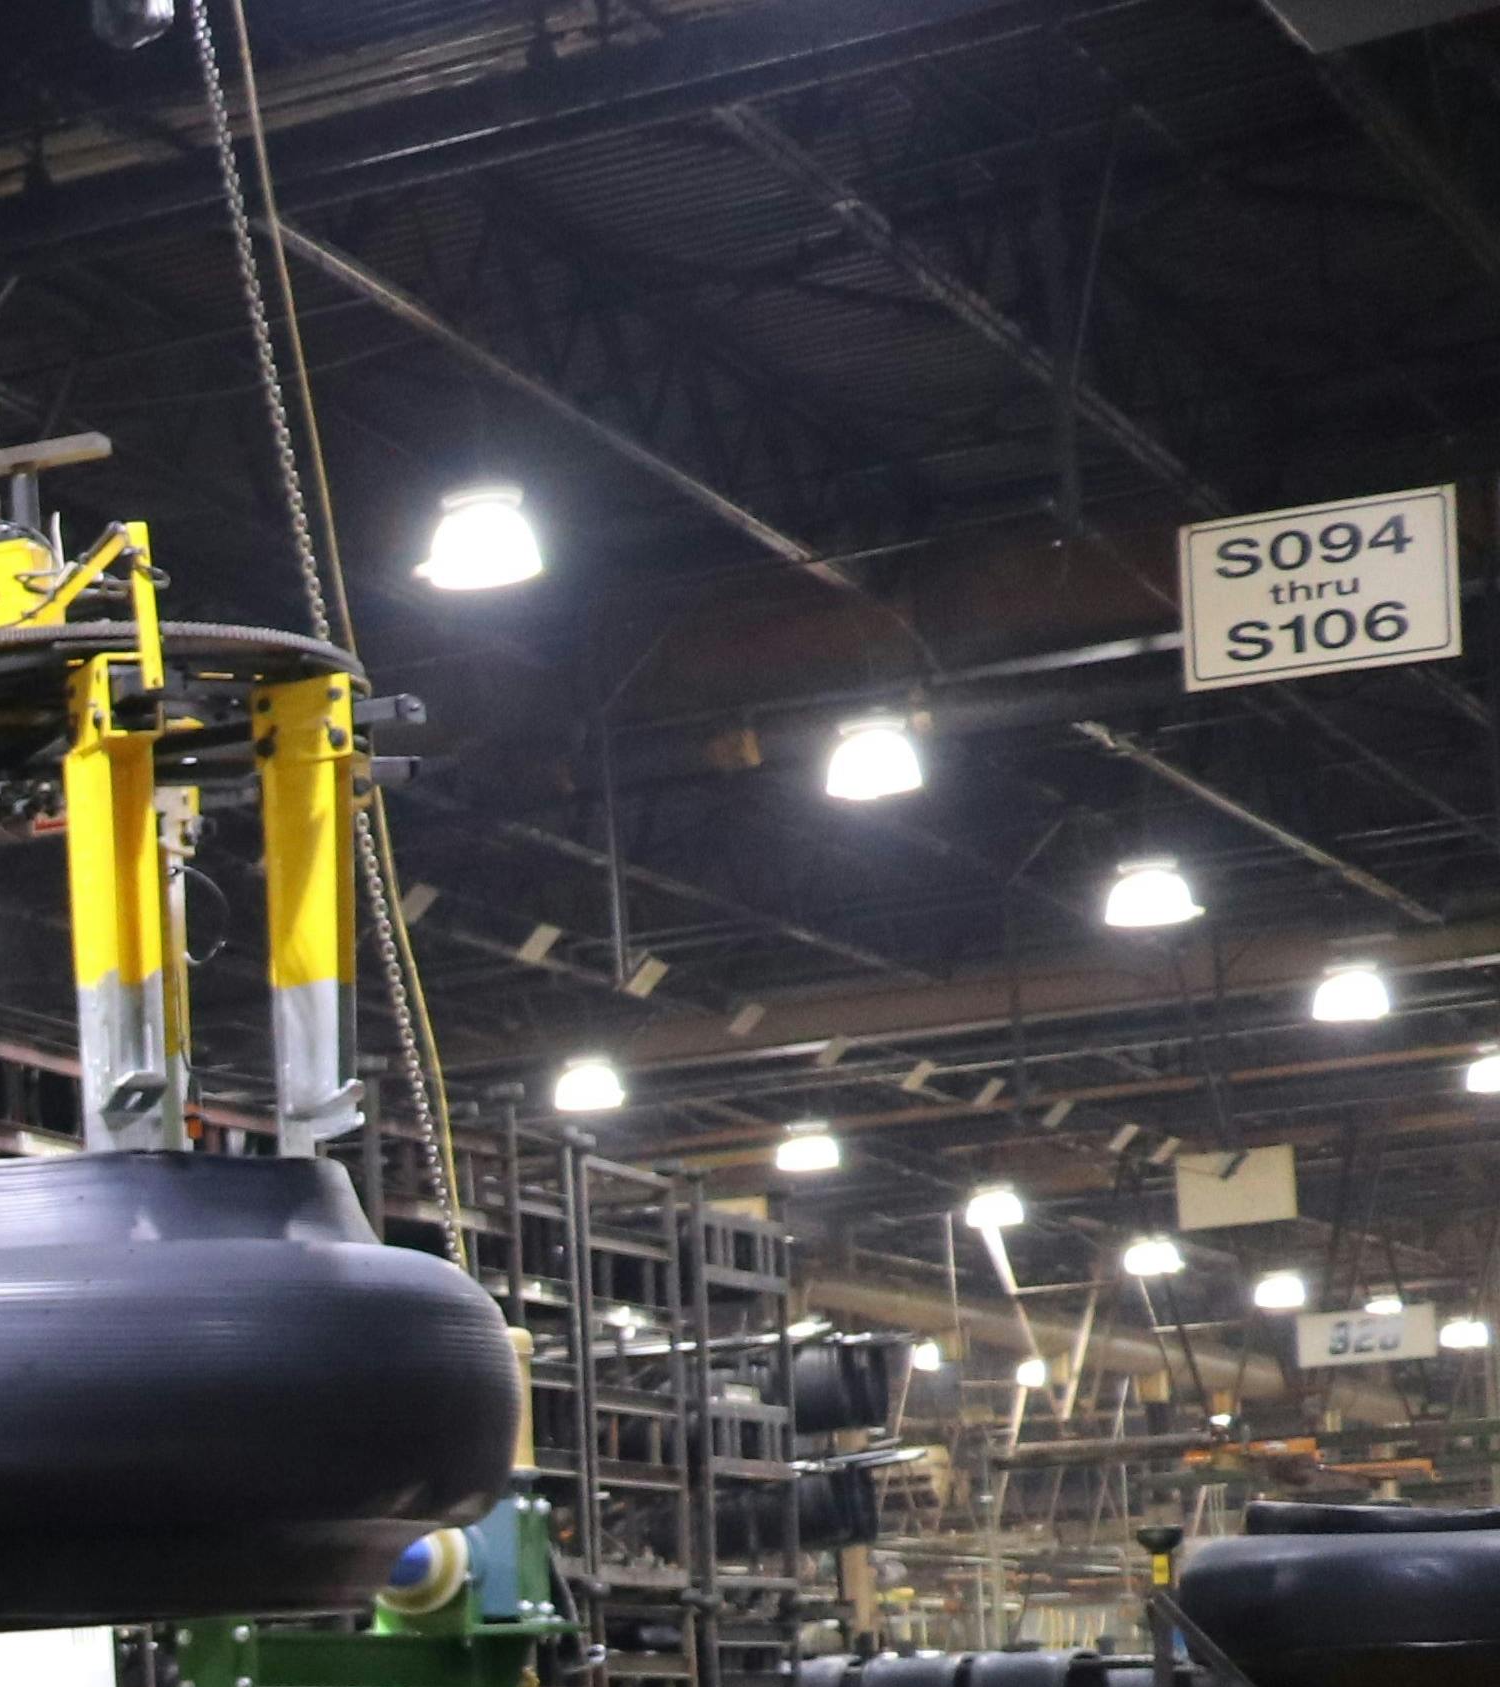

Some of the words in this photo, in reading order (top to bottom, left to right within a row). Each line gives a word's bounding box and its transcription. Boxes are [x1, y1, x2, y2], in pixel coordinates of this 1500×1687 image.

[1214, 513, 1413, 580] S094
[1268, 577, 1360, 606] thru
[1225, 600, 1410, 662] S106
